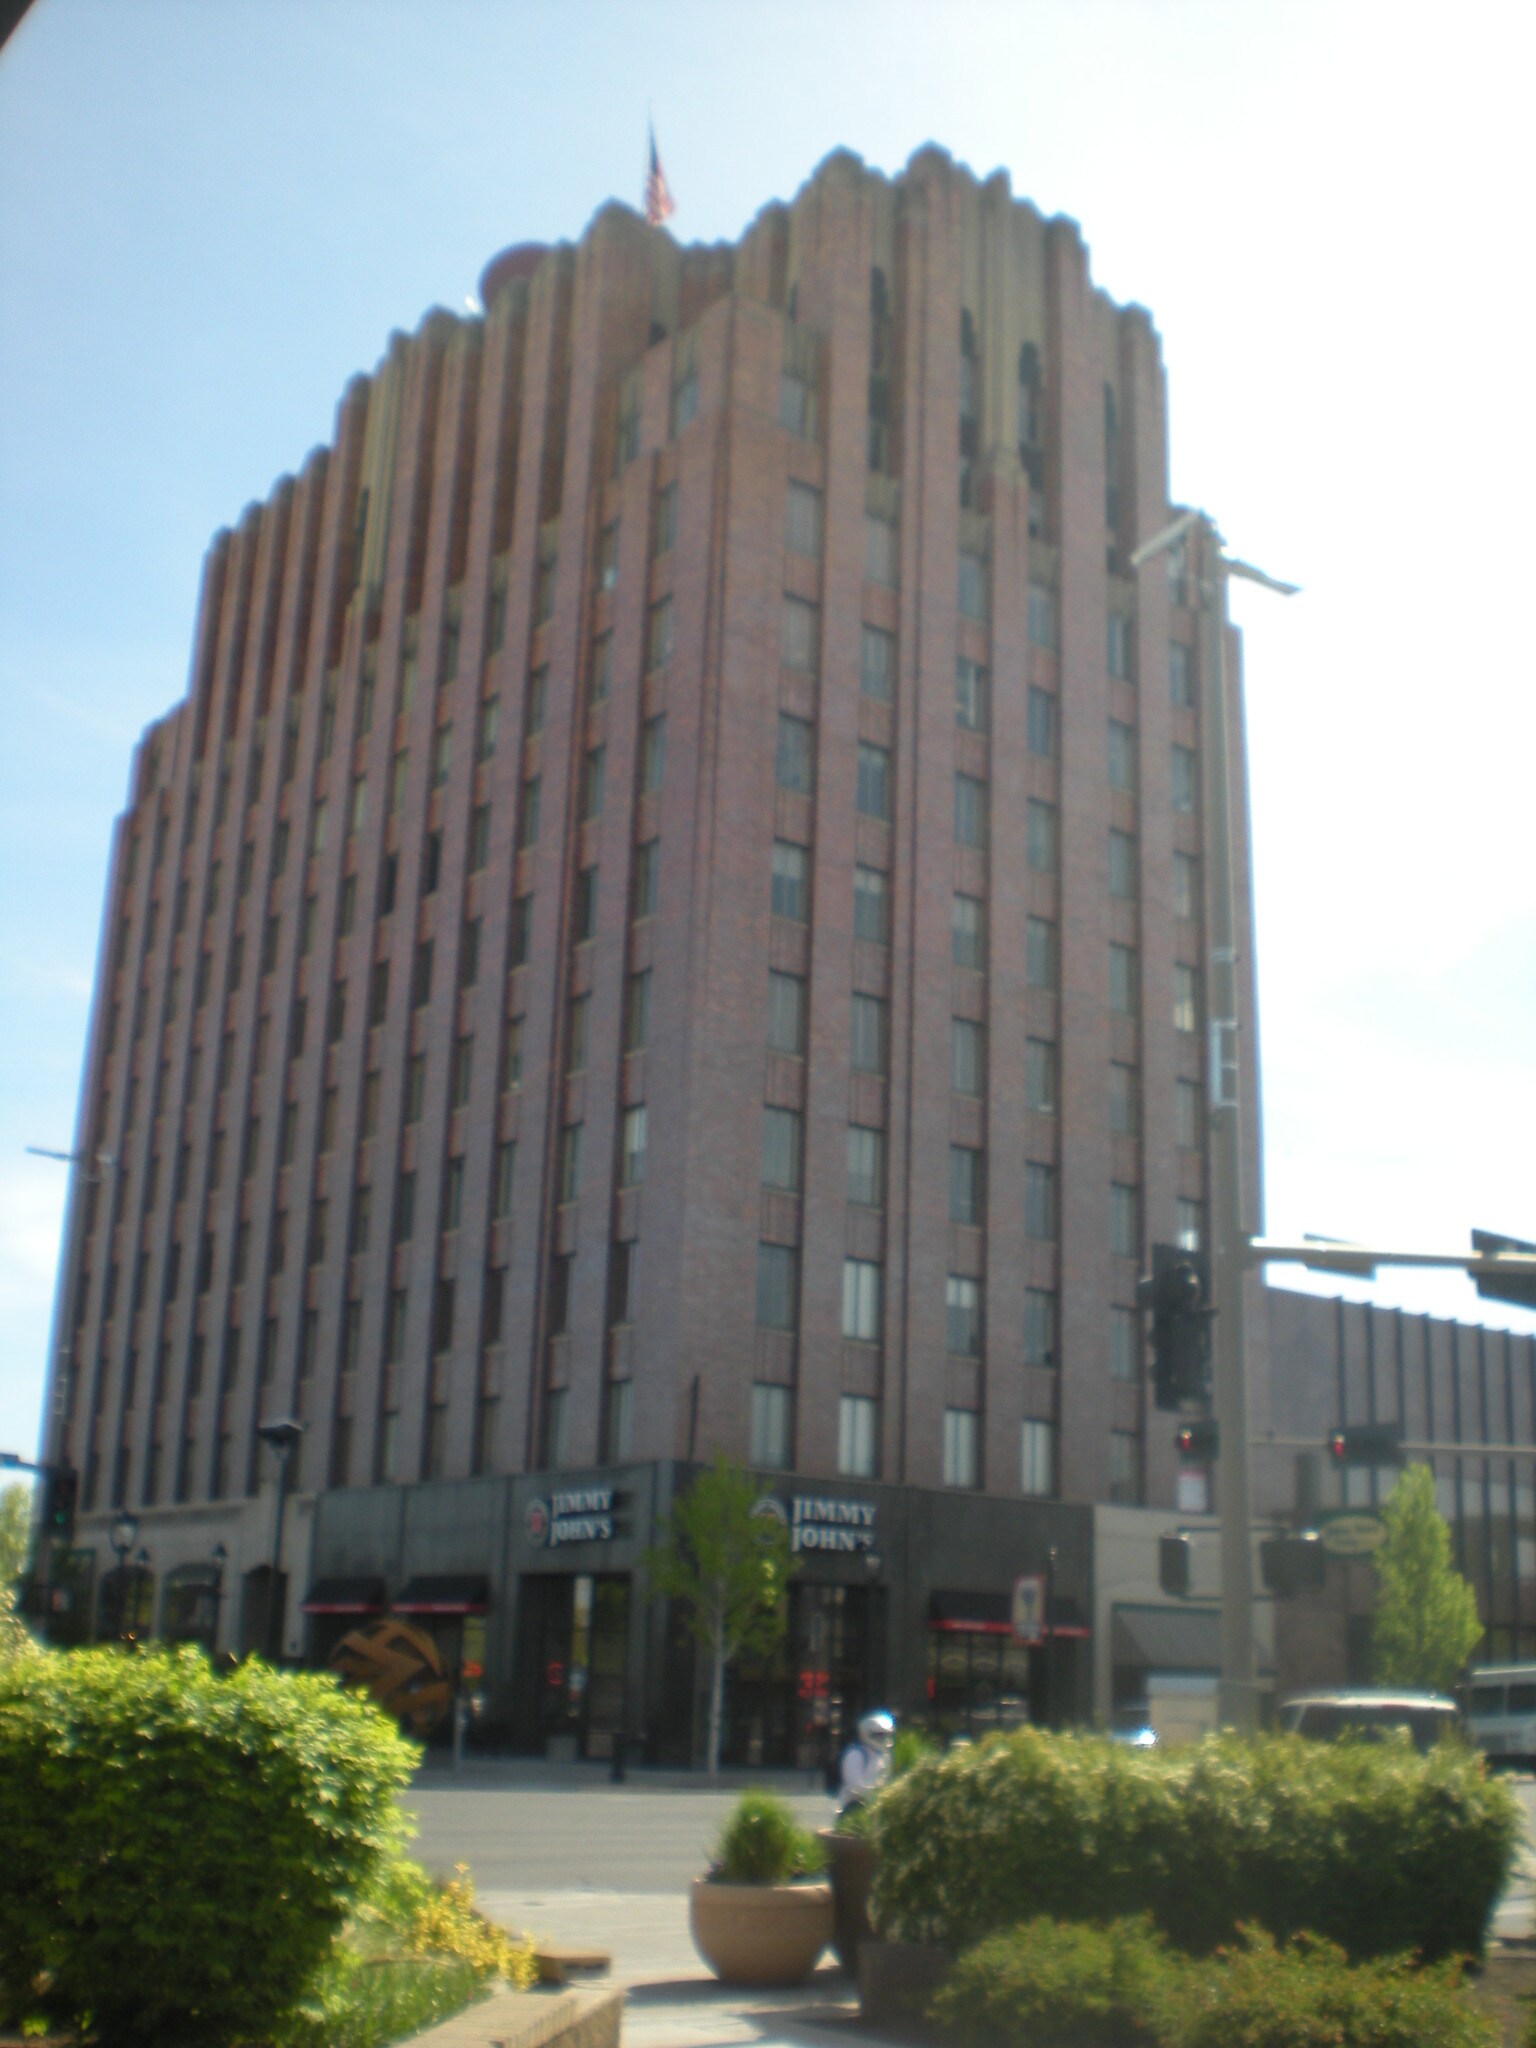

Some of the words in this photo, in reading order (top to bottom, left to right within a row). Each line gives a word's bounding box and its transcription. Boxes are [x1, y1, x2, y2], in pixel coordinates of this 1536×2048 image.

[551, 1490, 612, 1518] JIMMY
[792, 1497, 876, 1525] JIMMY
[549, 1517, 611, 1546] JOHN'S
[791, 1525, 874, 1551] JOHN'S
